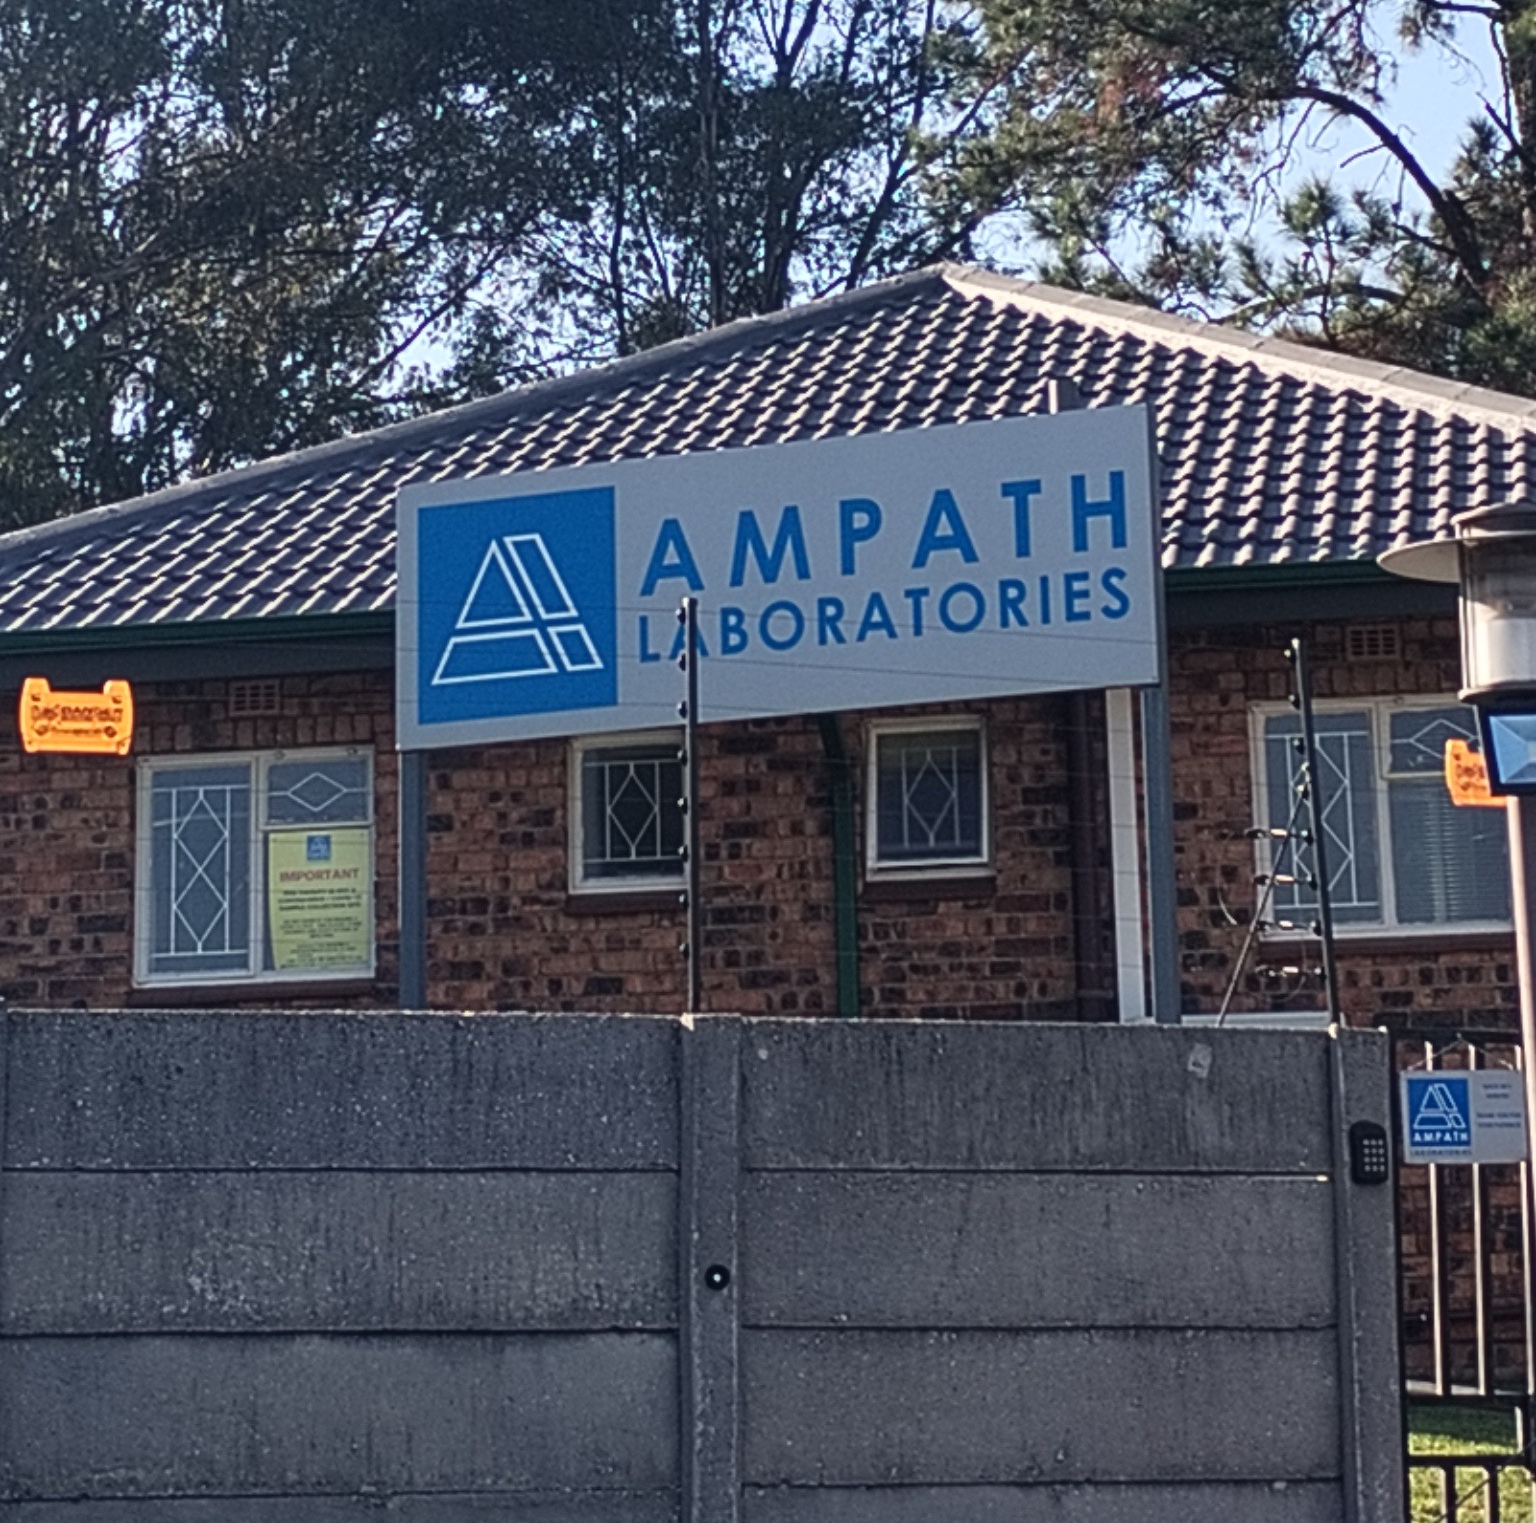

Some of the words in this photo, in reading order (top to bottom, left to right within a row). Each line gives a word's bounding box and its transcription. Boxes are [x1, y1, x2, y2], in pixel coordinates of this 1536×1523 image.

[639, 470, 1128, 596] AMPATH
[639, 567, 1131, 663] LABORATORIES
[280, 867, 360, 882] IMPORTANT
[1413, 1131, 1469, 1142] AMPATH
